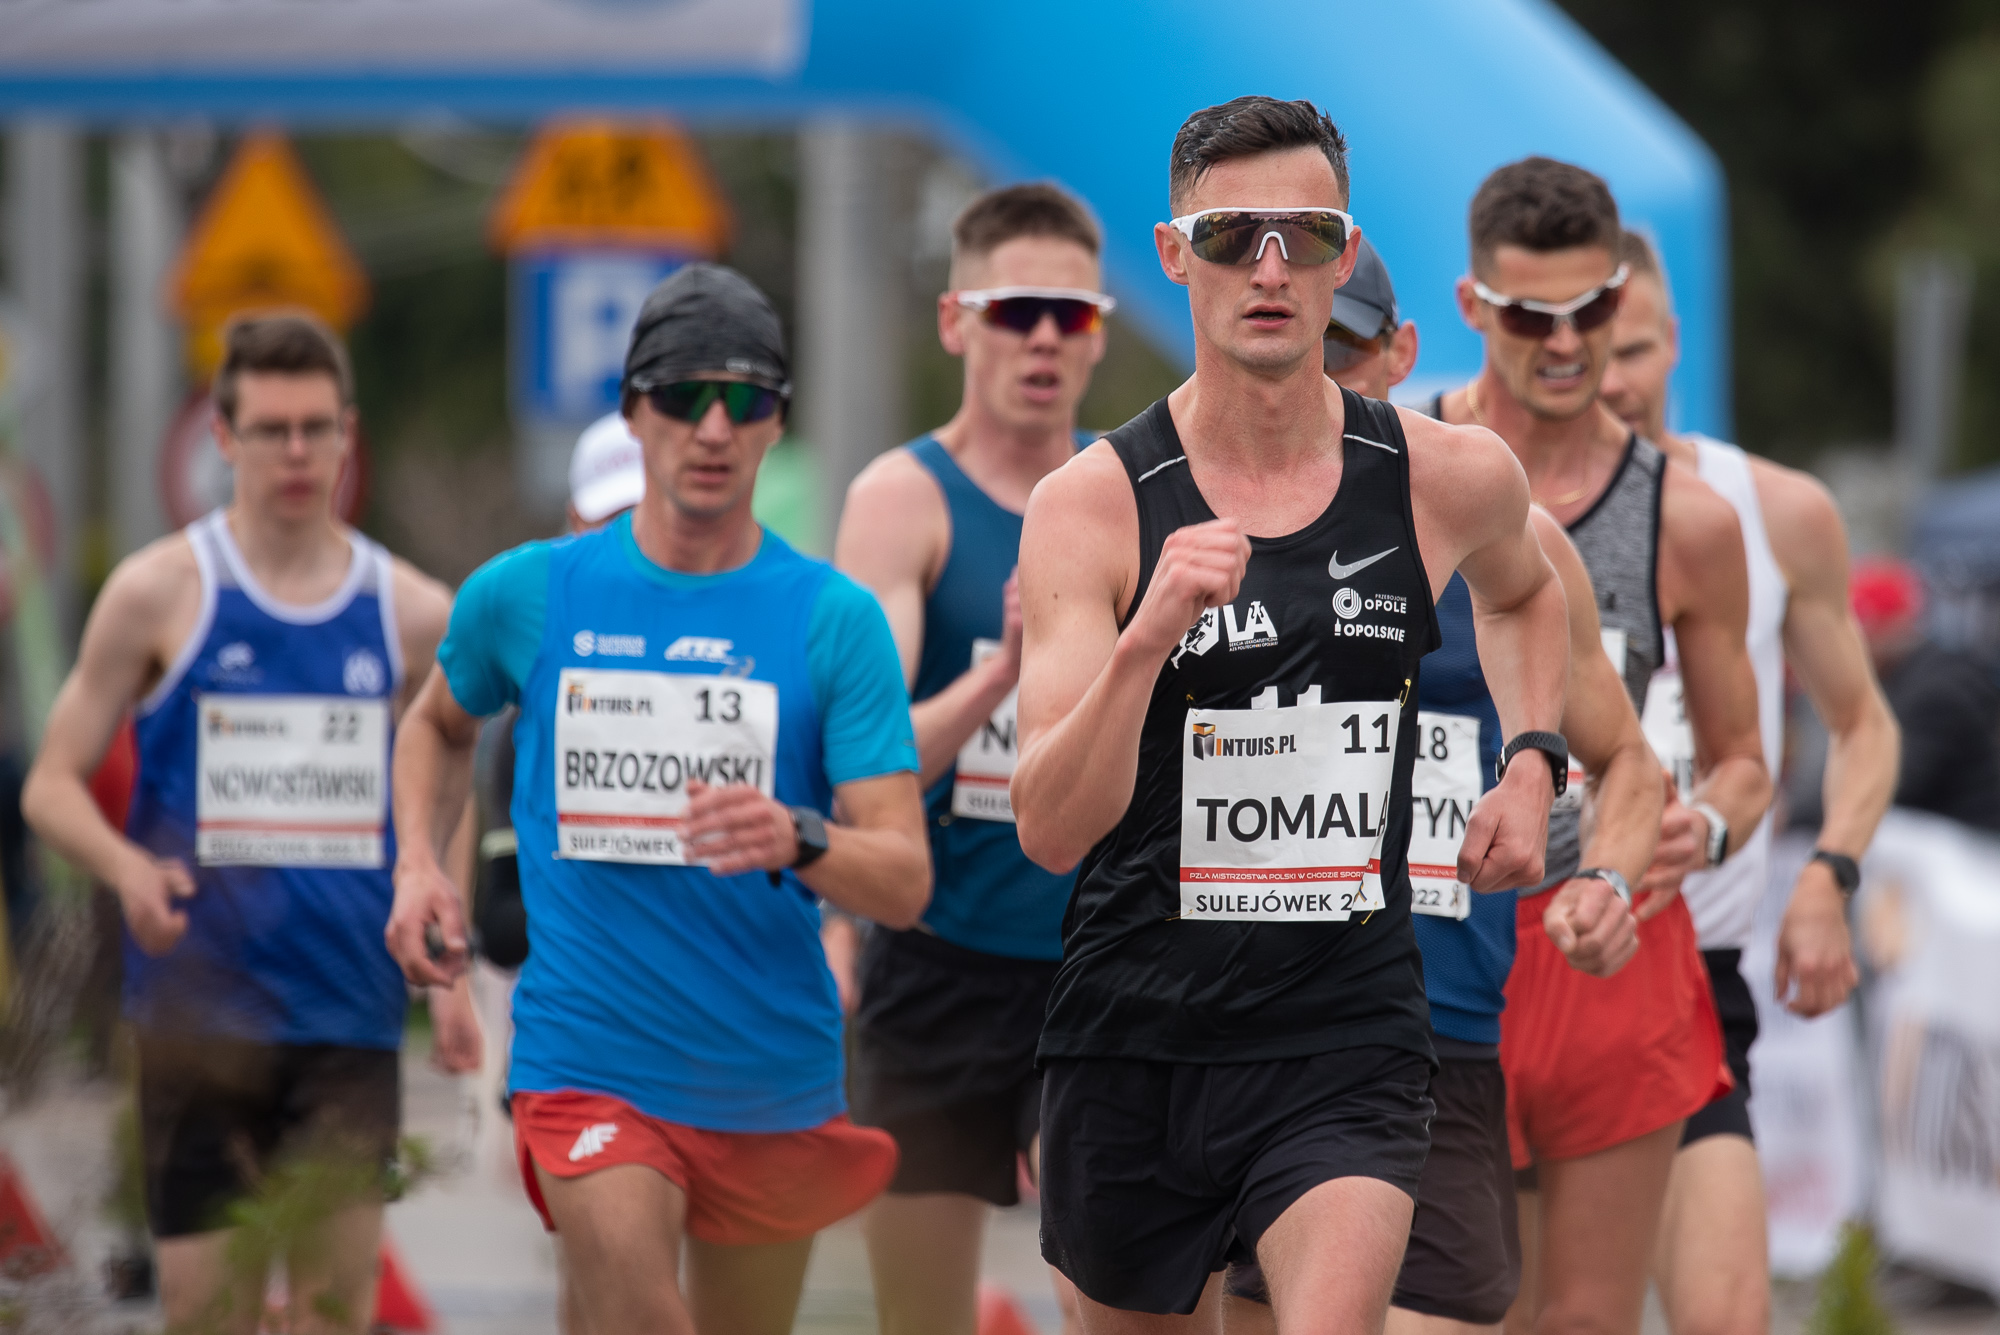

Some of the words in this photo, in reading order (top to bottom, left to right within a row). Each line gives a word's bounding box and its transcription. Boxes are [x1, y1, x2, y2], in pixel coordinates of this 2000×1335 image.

[1364, 599, 1407, 614] OPOLE
[1344, 624, 1405, 642] OPOLSKIE
[695, 690, 742, 723] 13
[1341, 714, 1390, 754] 11
[1216, 735, 1297, 757] INTUIS.PL
[565, 750, 764, 792] BRZOZOWSKI
[1197, 791, 1389, 842] TOMALA
[1189, 872, 1210, 880] PZLA
[1297, 872, 1306, 880] W
[1306, 871, 1339, 879] CHODZIE
[1196, 890, 1332, 912] SULEJÓWEK
